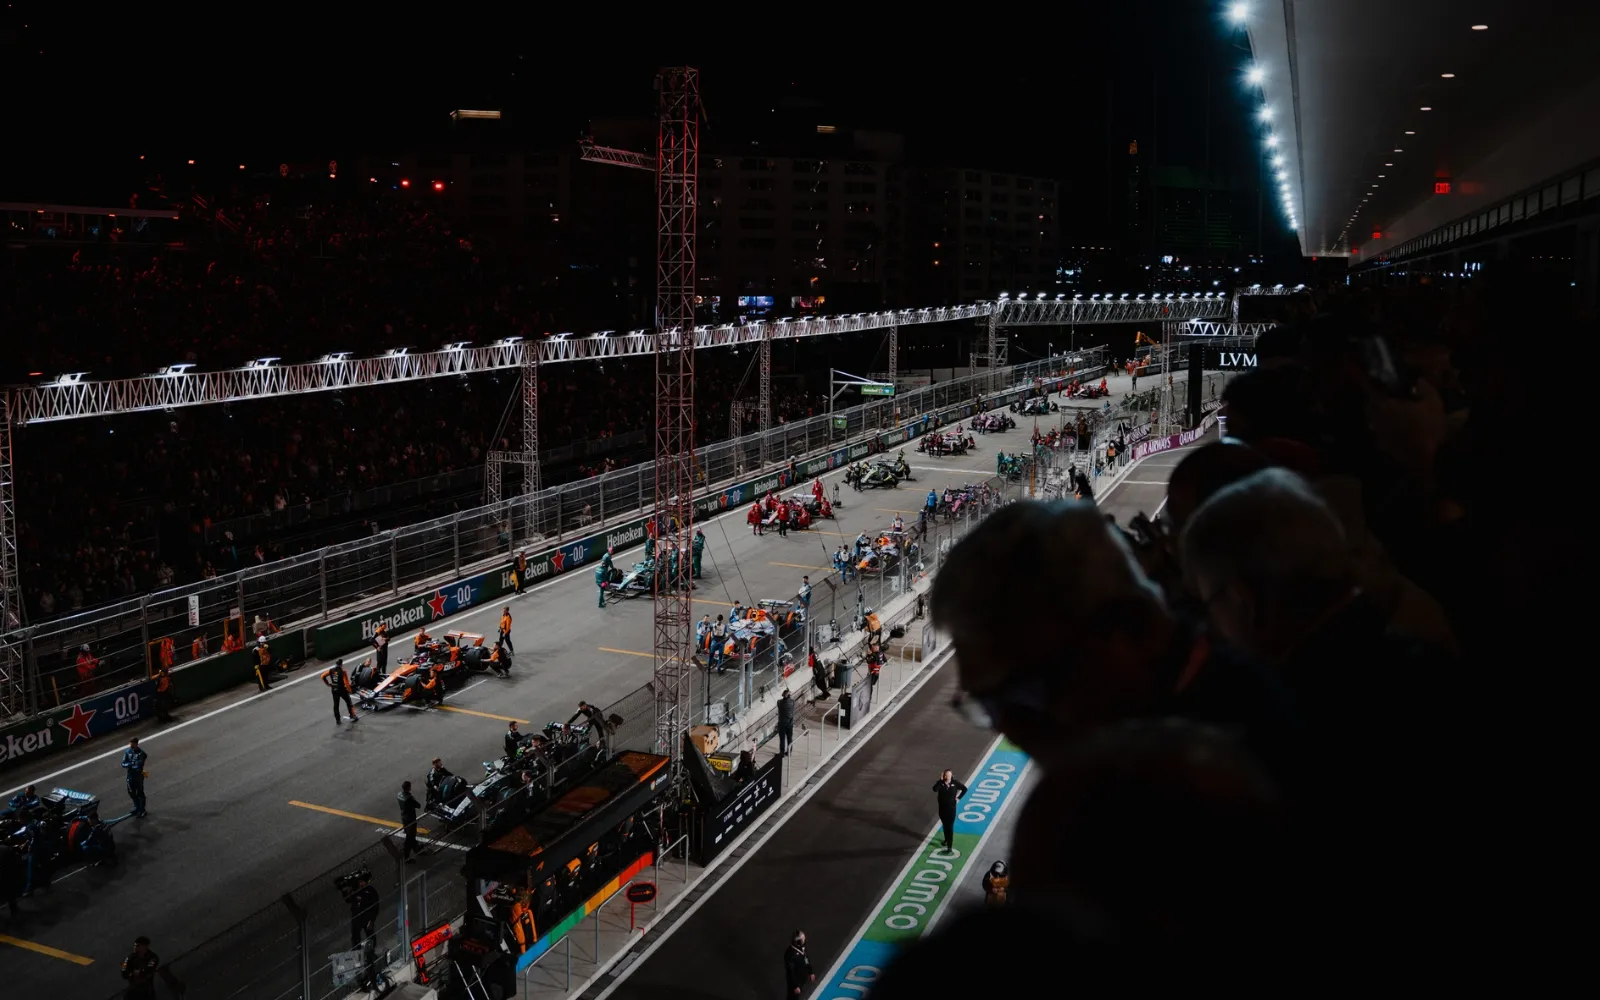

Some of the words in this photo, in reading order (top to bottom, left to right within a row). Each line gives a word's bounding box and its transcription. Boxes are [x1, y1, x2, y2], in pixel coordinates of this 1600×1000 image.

[1219, 352, 1258, 367] LVM
[607, 527, 644, 550] Heineken
[501, 561, 549, 589] Heken
[957, 763, 1016, 823] aramco
[884, 847, 961, 931] aramco
